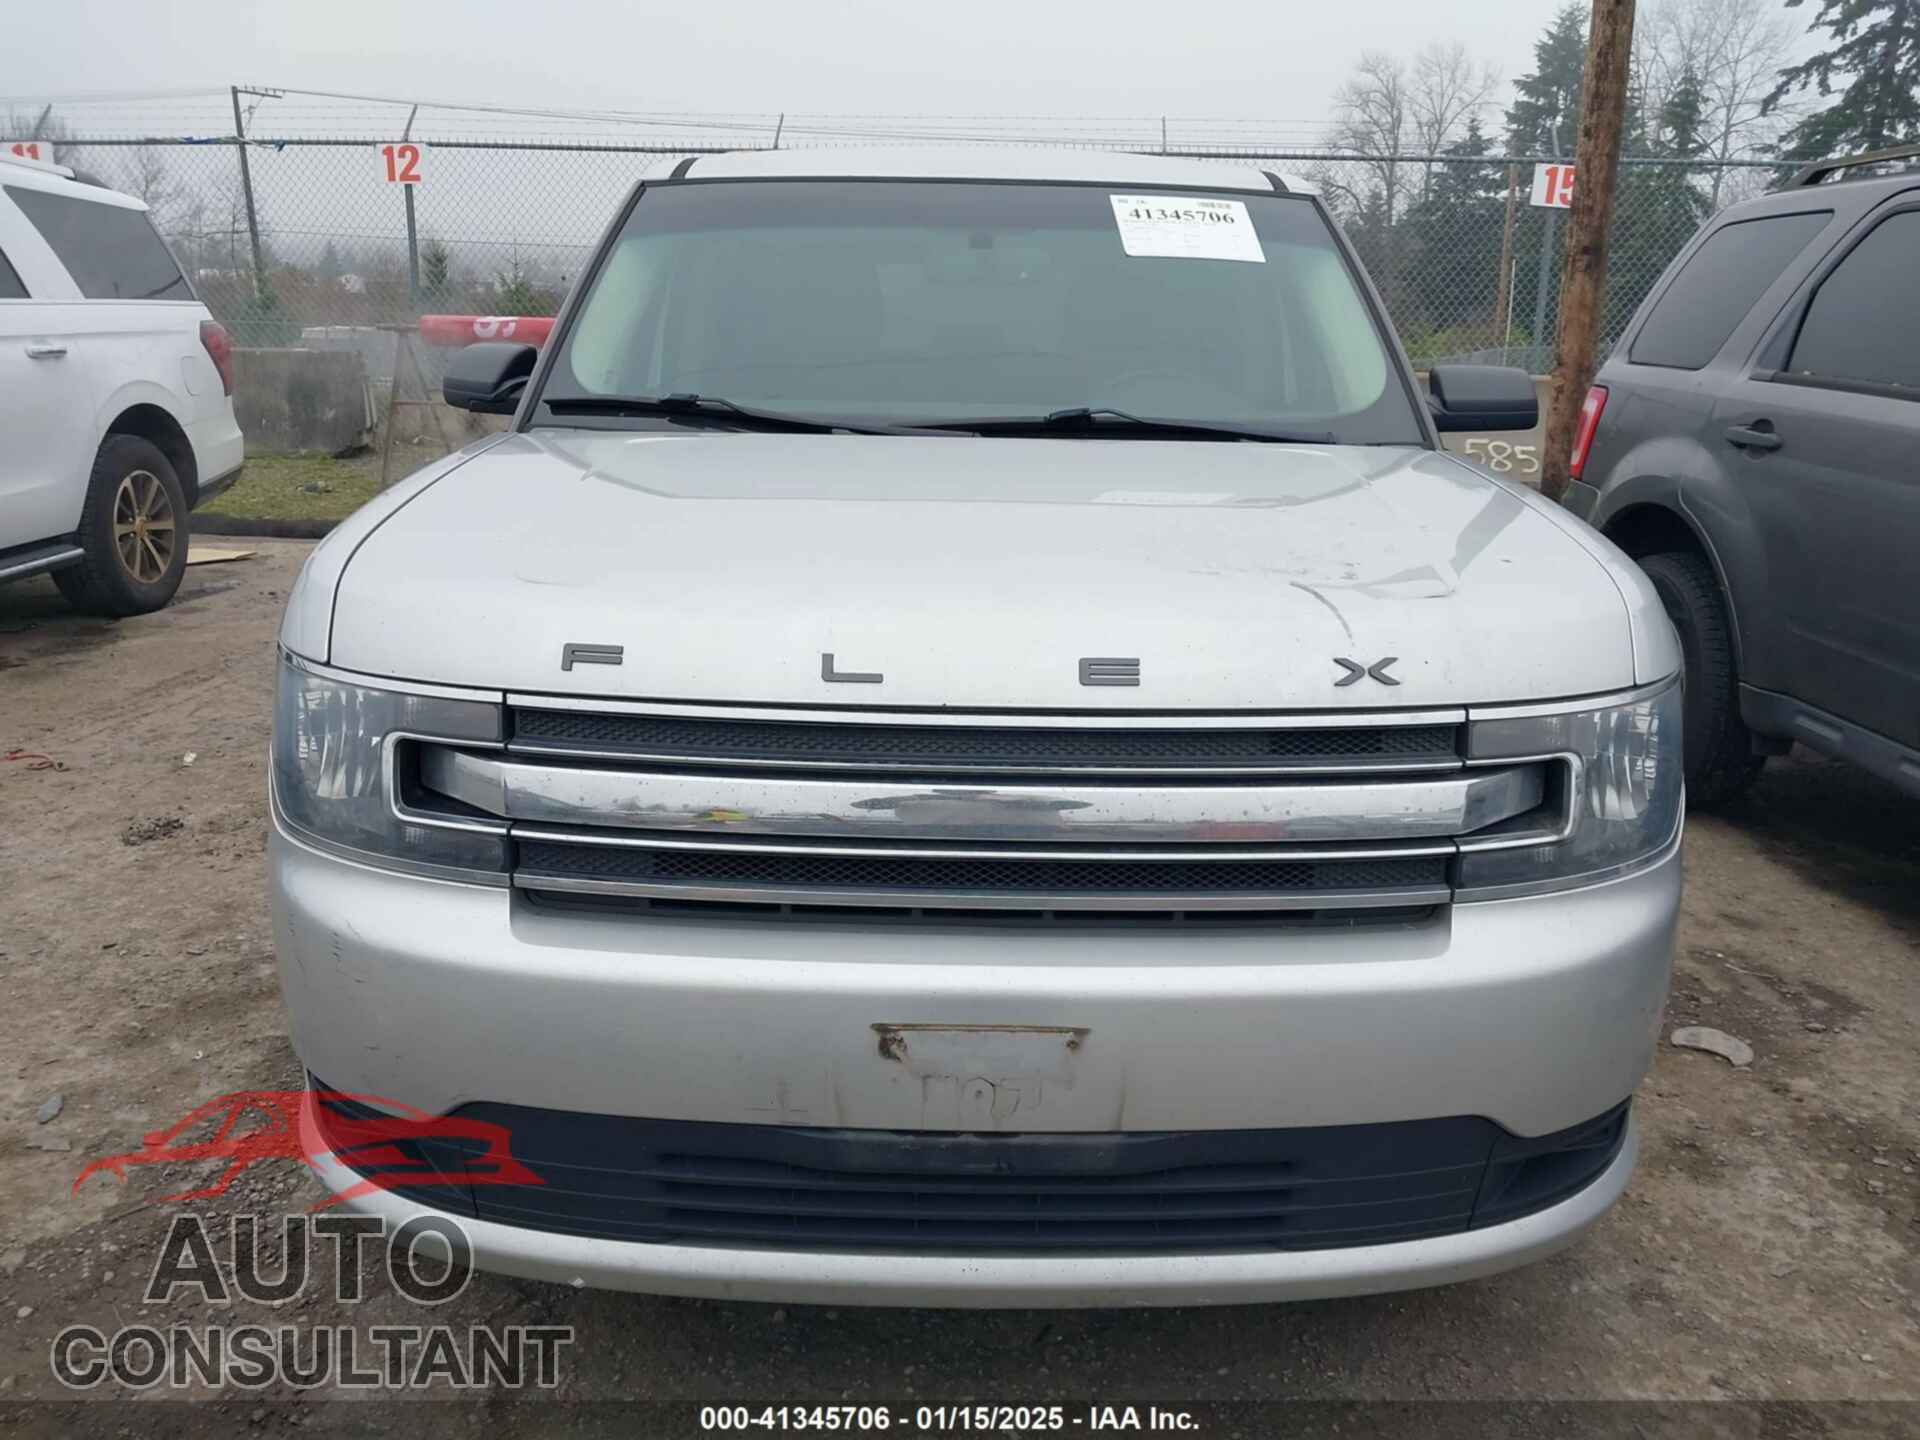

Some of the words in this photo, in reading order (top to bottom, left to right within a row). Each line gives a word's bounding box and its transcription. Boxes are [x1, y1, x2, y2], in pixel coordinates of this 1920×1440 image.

[383, 144, 421, 182] 12
[1129, 208, 1235, 224] 41345706
[1465, 438, 1539, 472] 585
